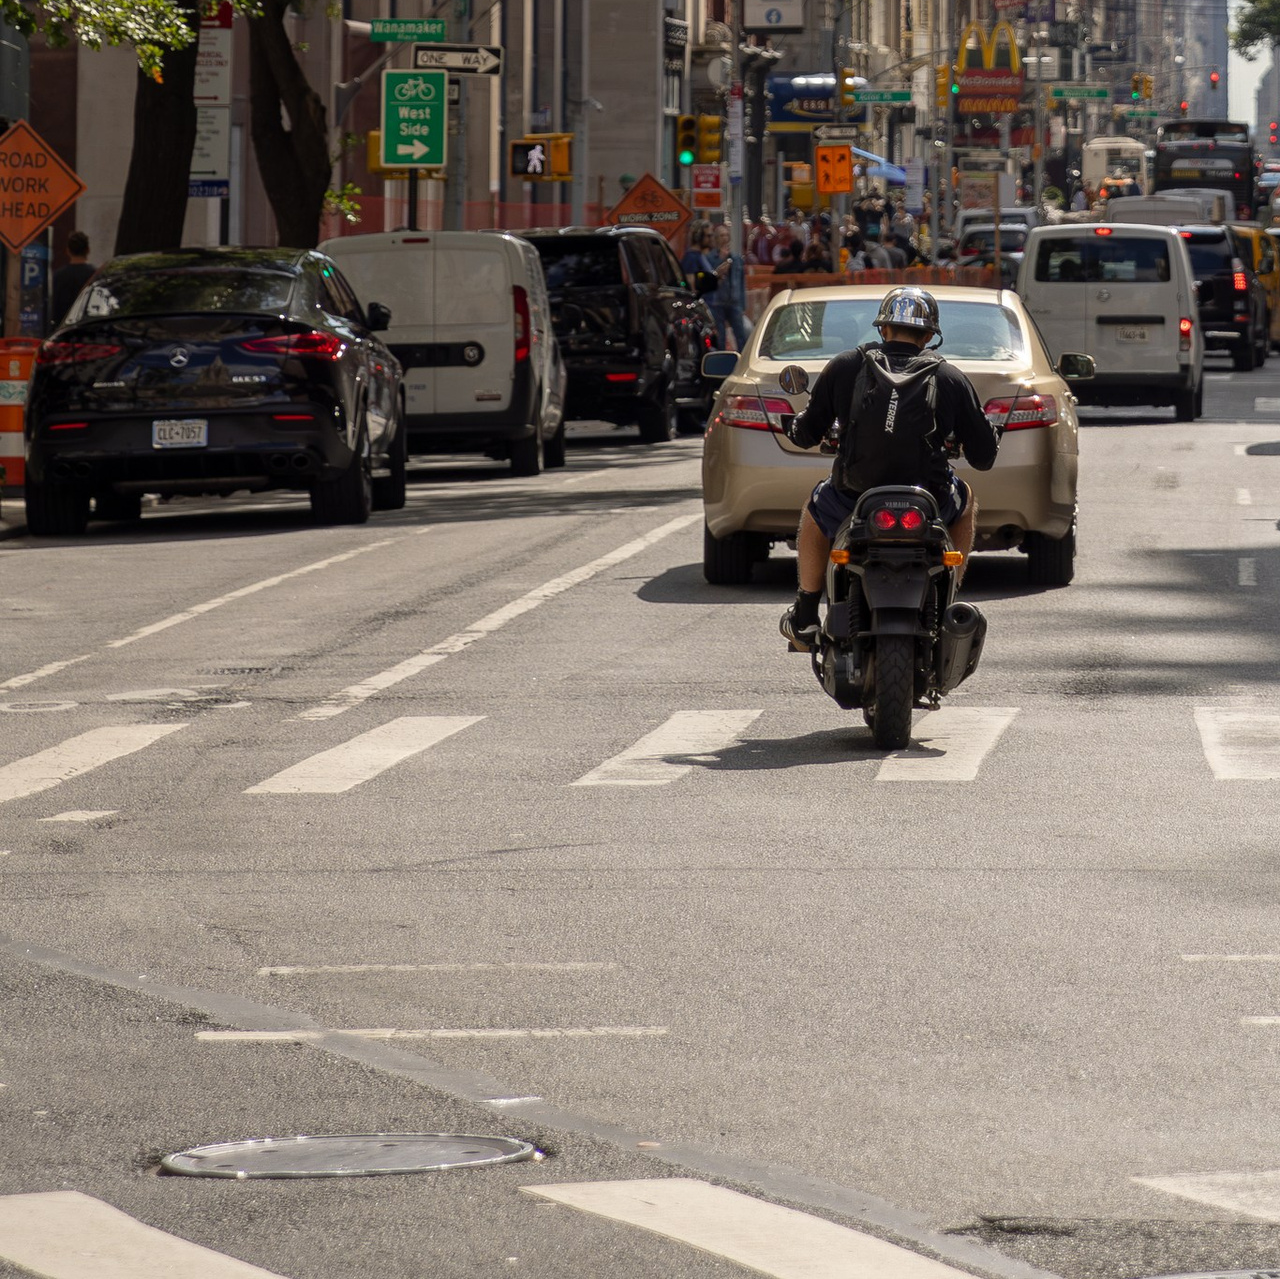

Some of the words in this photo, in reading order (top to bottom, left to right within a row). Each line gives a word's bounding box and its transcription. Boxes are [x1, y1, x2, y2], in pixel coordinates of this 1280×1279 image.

[373, 20, 443, 33] Wanamaker
[420, 52, 447, 64] ONE
[461, 53, 492, 65] WAY
[398, 106, 431, 119] West
[400, 122, 430, 136] Side
[0, 152, 48, 168] ROAD
[0, 202, 51, 218] HEAD
[619, 212, 651, 222] WORK
[651, 211, 680, 221] ZONE
[885, 400, 899, 434] TERREX
